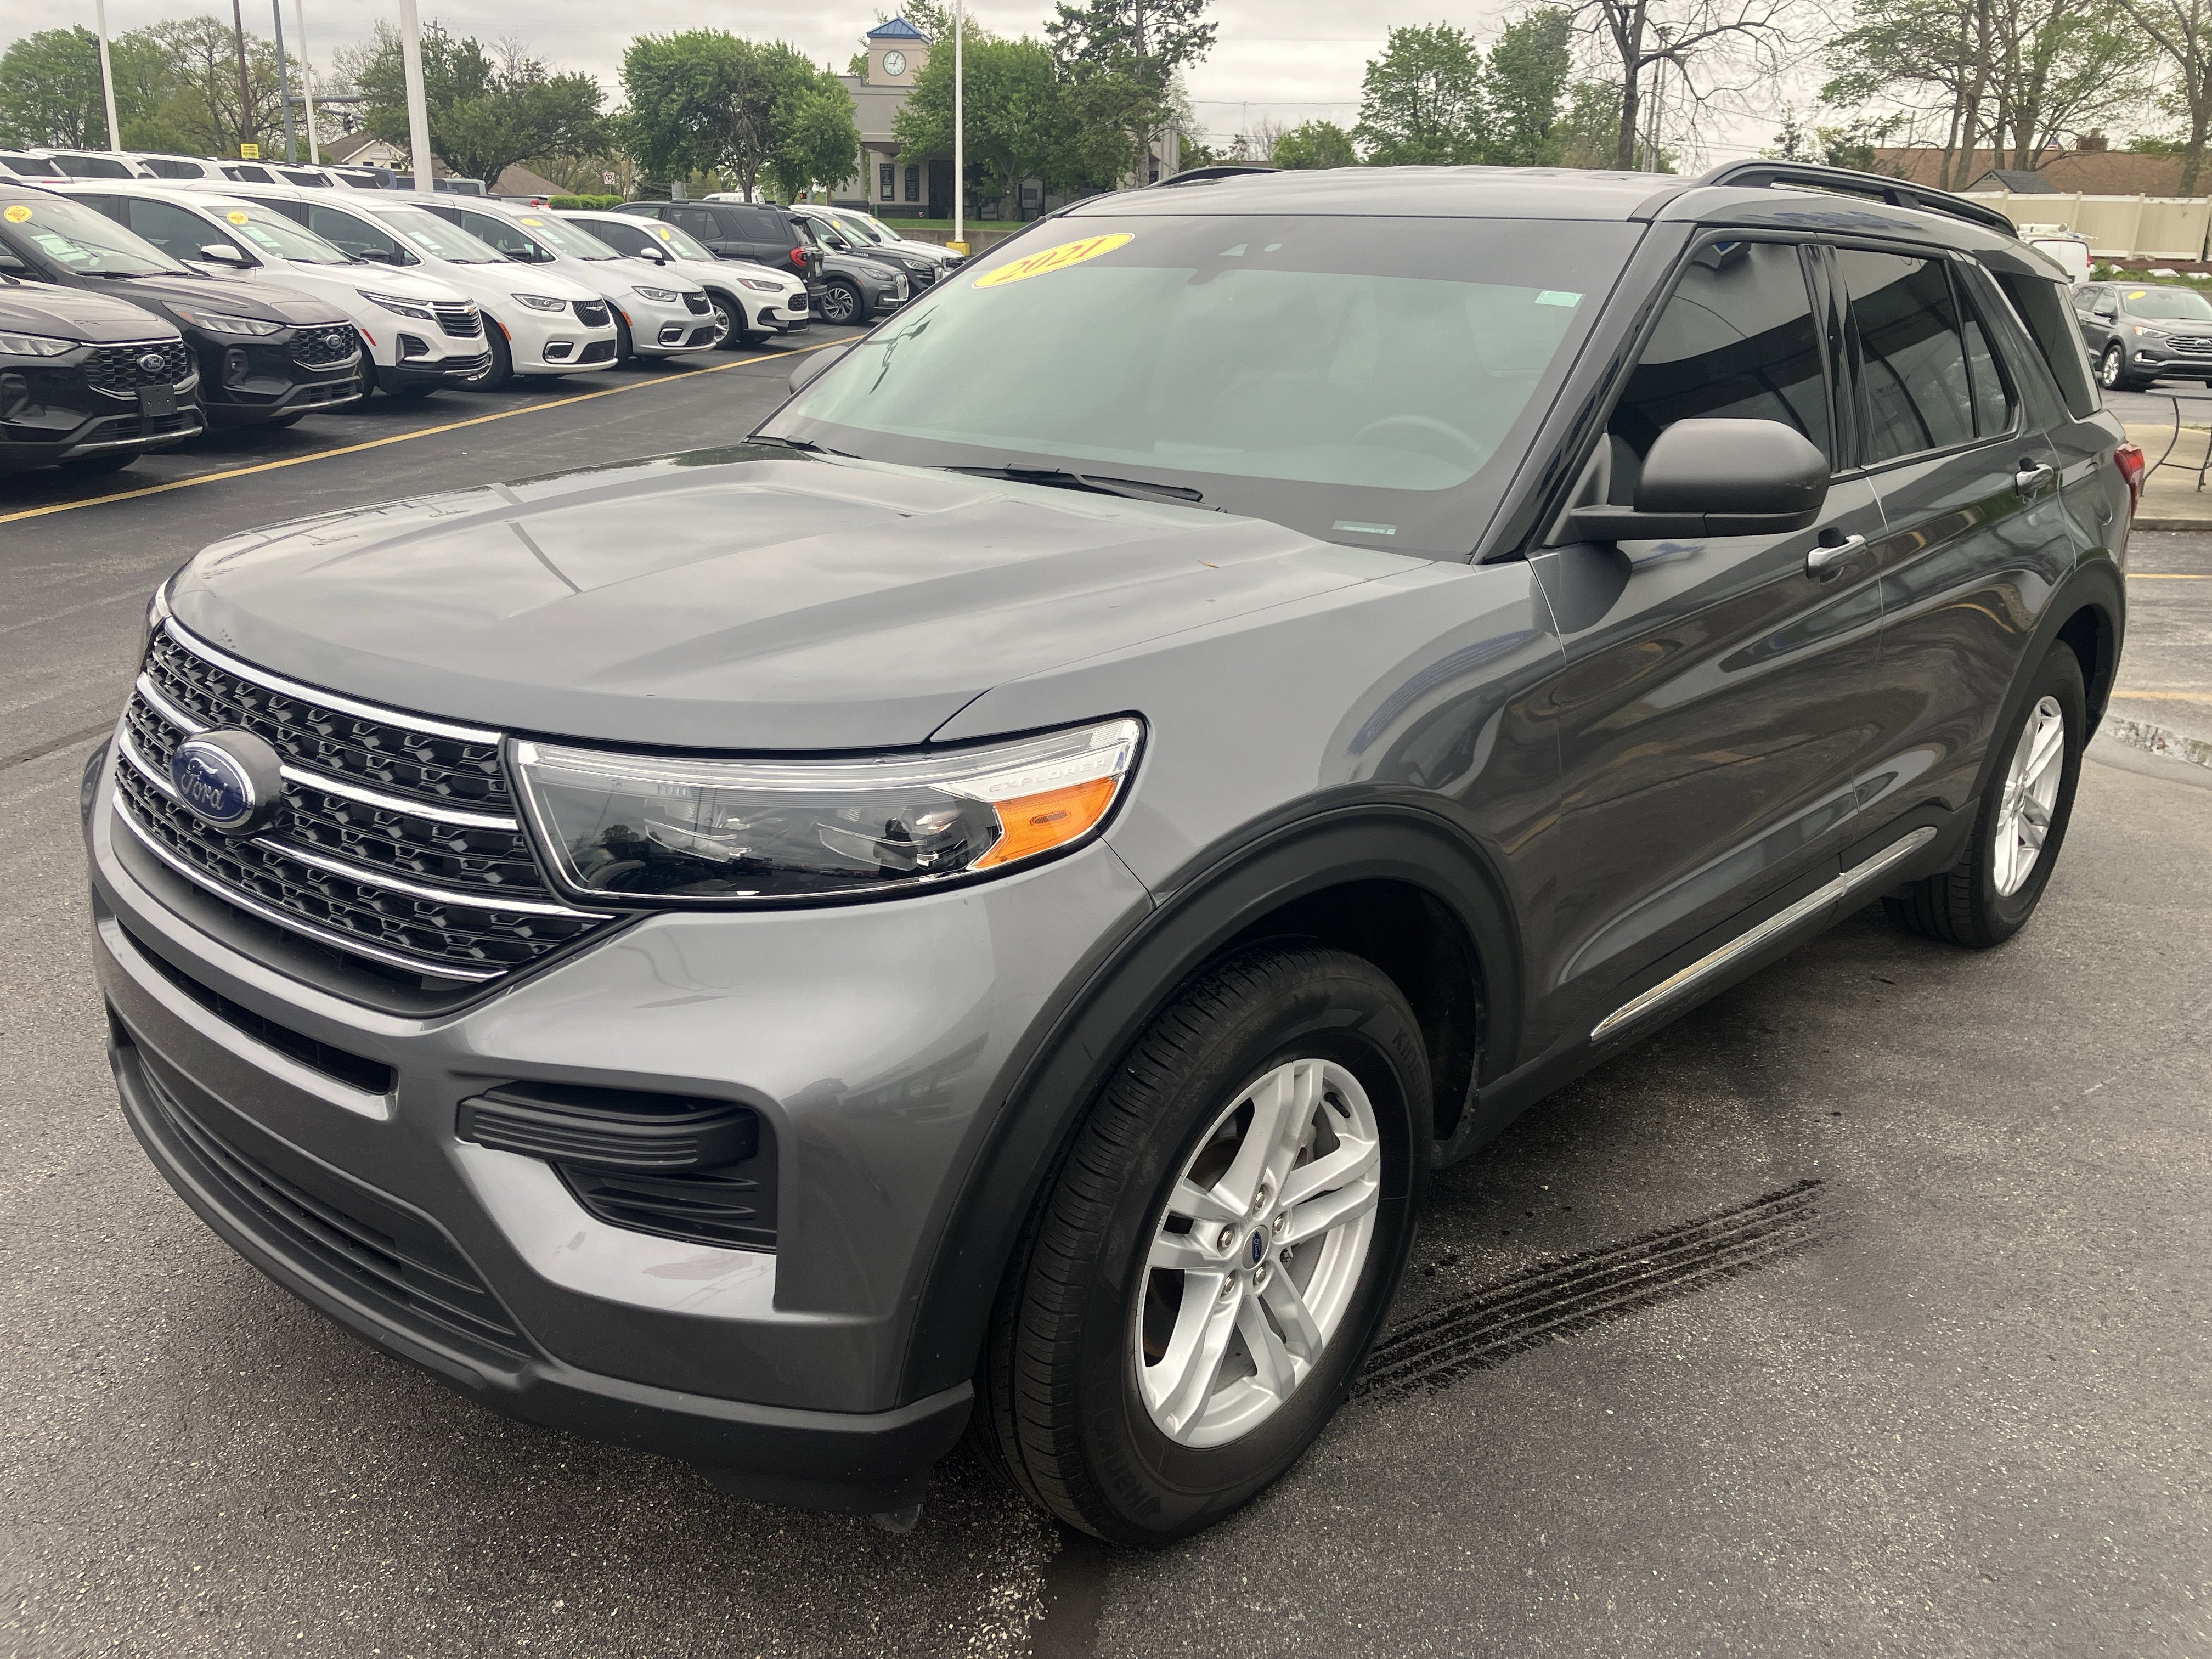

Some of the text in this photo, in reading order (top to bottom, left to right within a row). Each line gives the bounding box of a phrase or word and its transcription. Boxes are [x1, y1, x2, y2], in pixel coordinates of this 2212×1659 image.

[993, 238, 1108, 283] 2021
[181, 757, 229, 811] Ford
[988, 758, 1107, 792] EXPLORER
